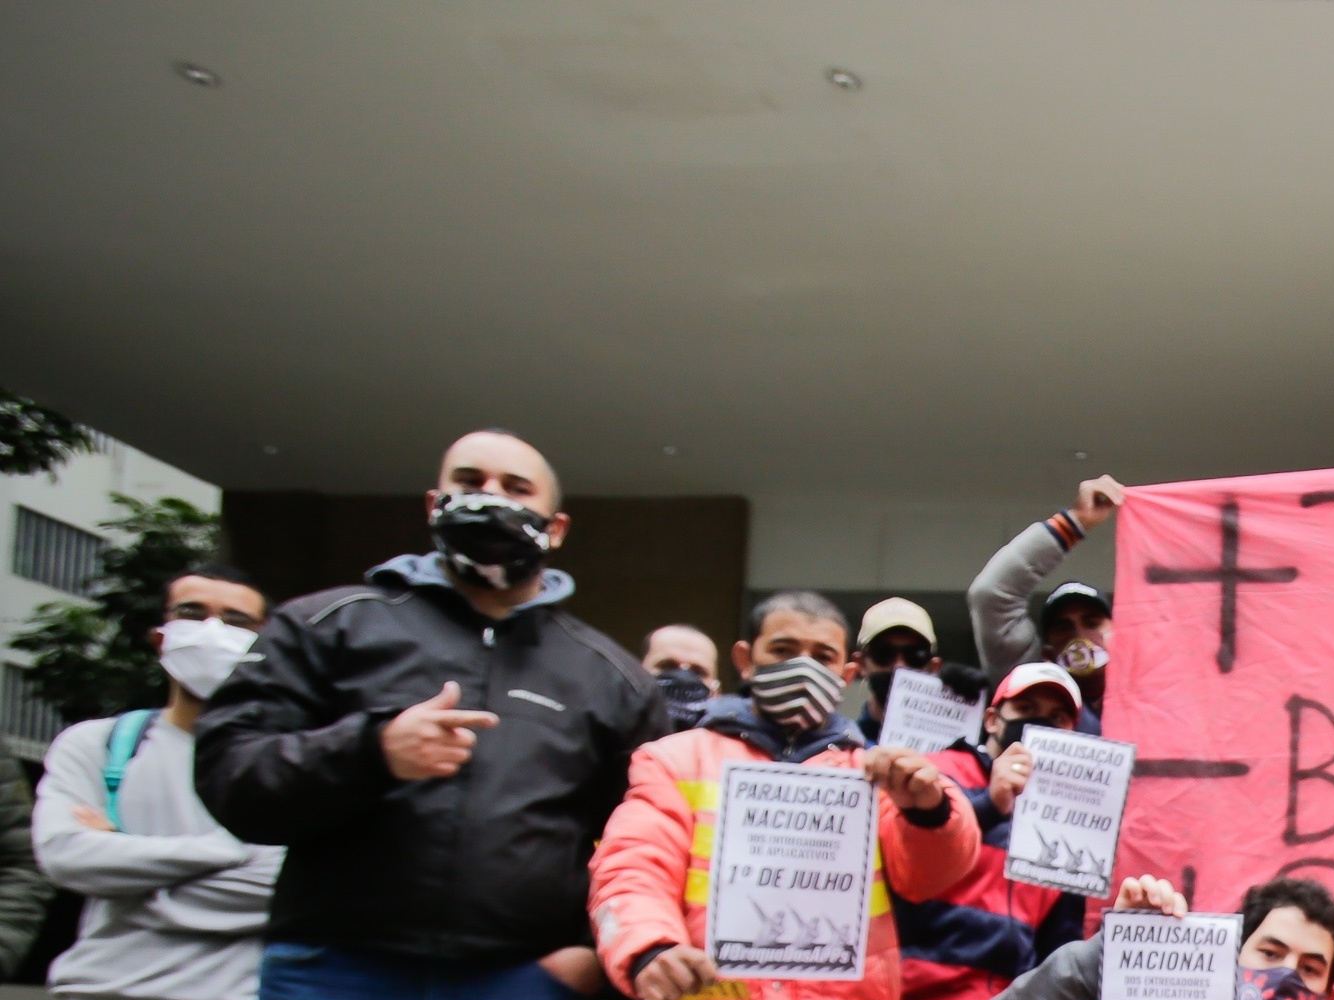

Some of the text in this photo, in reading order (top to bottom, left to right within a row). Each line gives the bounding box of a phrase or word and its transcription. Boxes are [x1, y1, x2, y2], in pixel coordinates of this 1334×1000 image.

[735, 782, 860, 808] PARALISAÇÃO
[744, 809, 846, 834] NACIONAL
[1041, 804, 1112, 831] DE JULHO
[758, 868, 853, 892] DE JULHO
[1112, 924, 1228, 950] PARALISAÇÃO
[1119, 951, 1215, 972] NACIONAL
